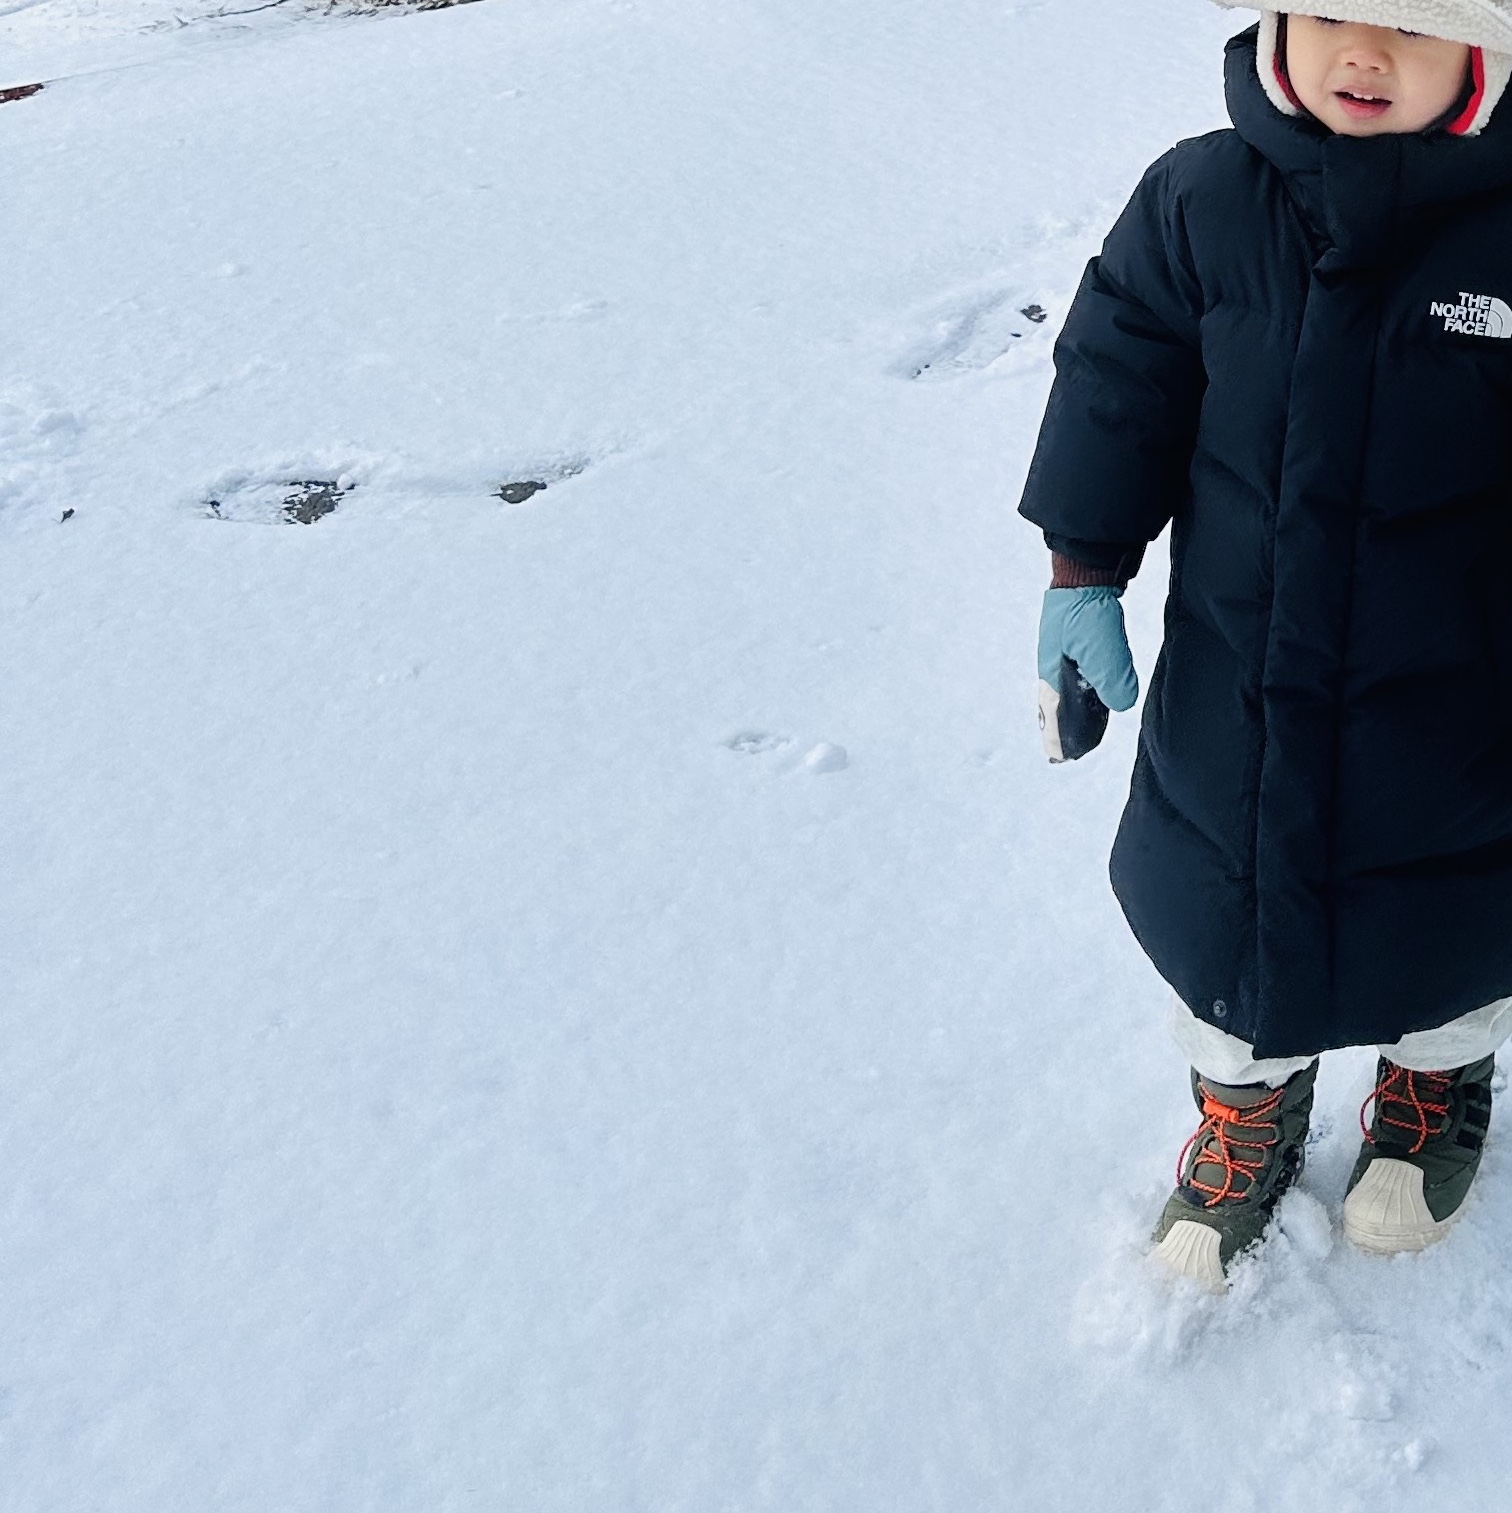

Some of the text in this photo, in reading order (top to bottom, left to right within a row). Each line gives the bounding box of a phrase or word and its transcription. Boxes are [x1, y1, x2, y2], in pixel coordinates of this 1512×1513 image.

[1459, 291, 1492, 309] THE
[1429, 301, 1489, 323] NORTH
[1444, 318, 1486, 336] FACE
